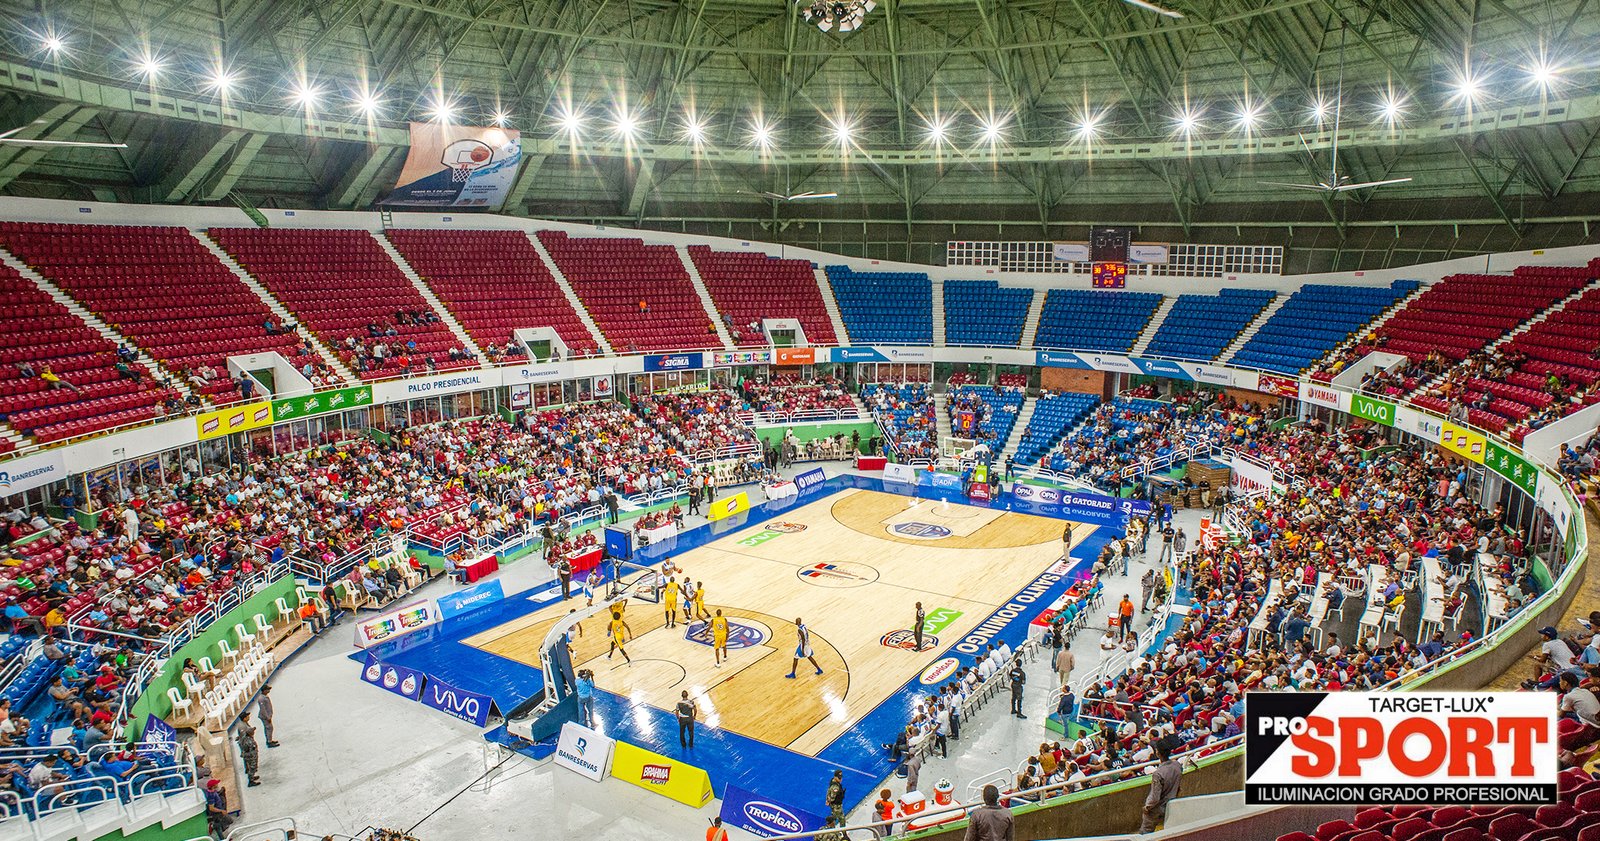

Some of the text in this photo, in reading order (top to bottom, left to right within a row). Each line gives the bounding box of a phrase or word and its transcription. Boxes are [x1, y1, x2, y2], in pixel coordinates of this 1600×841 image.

[408, 376, 481, 392] PALCO PRESIDENCIAL
[1314, 390, 1337, 403] YAMAHA
[12, 464, 54, 483] BANRESERVAS
[804, 472, 825, 485] YAMAHA
[1072, 498, 1112, 509] GATORADE
[956, 573, 1060, 653] SANTO DOMINGO
[559, 750, 597, 772] BANRESERVAS
[643, 766, 668, 779] BRAHMA
